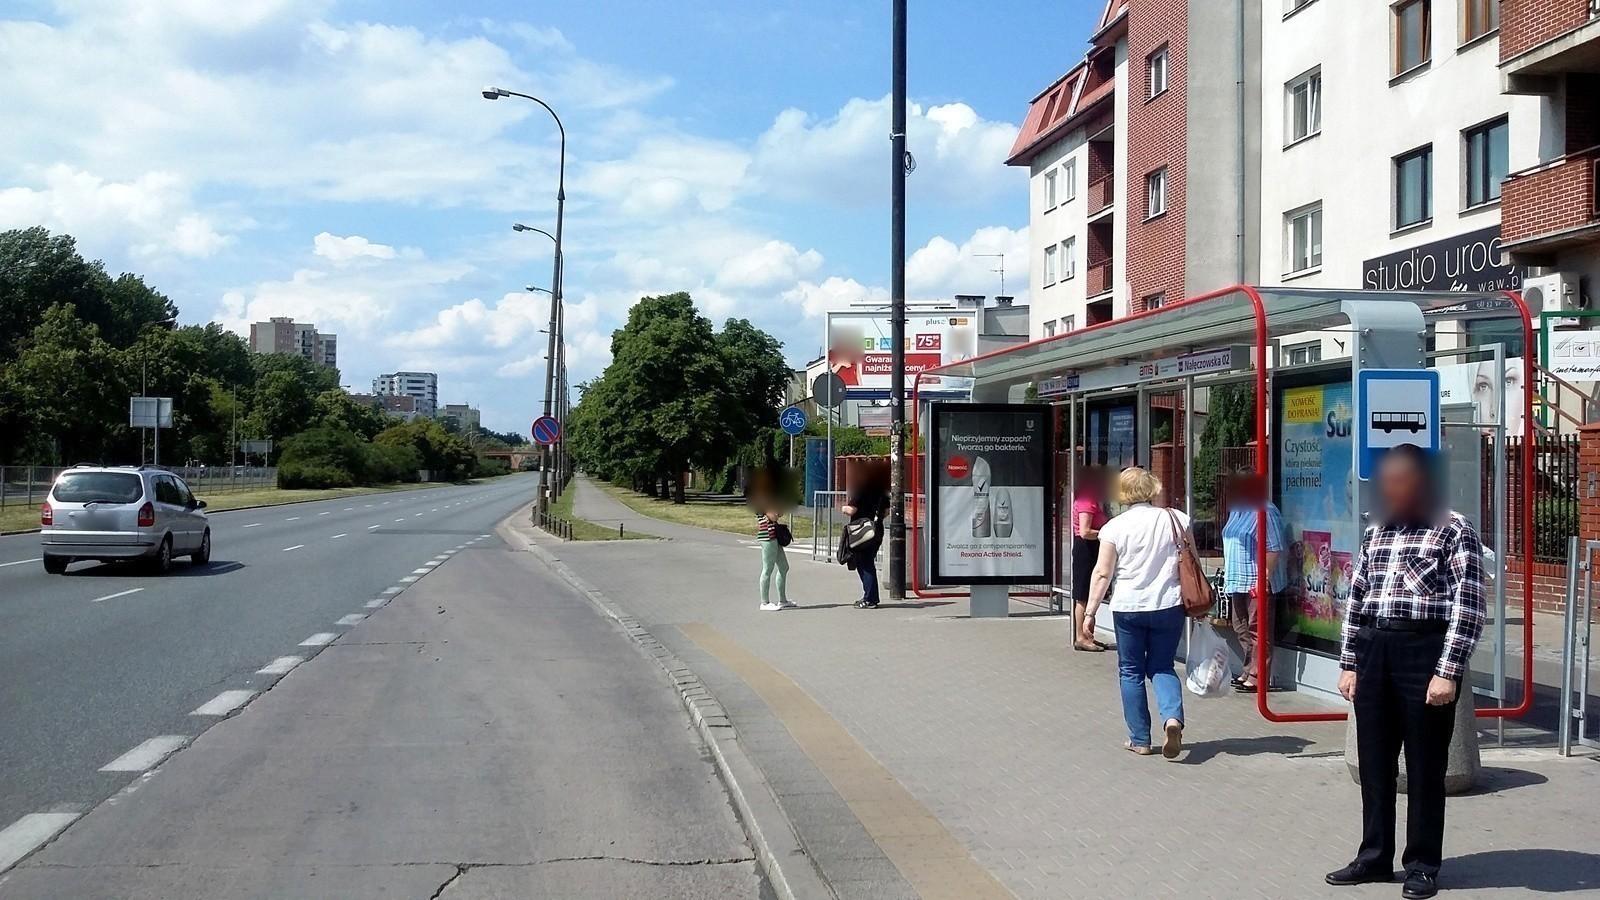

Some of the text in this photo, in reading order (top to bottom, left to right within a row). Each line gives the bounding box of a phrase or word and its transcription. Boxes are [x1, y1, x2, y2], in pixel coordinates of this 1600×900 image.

[1366, 248, 1437, 291] studio
[925, 318, 941, 326] plus
[917, 335, 933, 347] 75
[904, 364, 926, 373] ceny!
[1184, 356, 1221, 372] Nałęczowska
[1221, 353, 1230, 365] 02
[1139, 364, 1153, 376] ams
[1326, 410, 1352, 438] Sur
[951, 434, 1032, 443] Nieprzyjemny zapach?
[956, 443, 984, 451] Tworzą
[994, 443, 1026, 451] bakterie.
[1285, 472, 1322, 491] pachnie!
